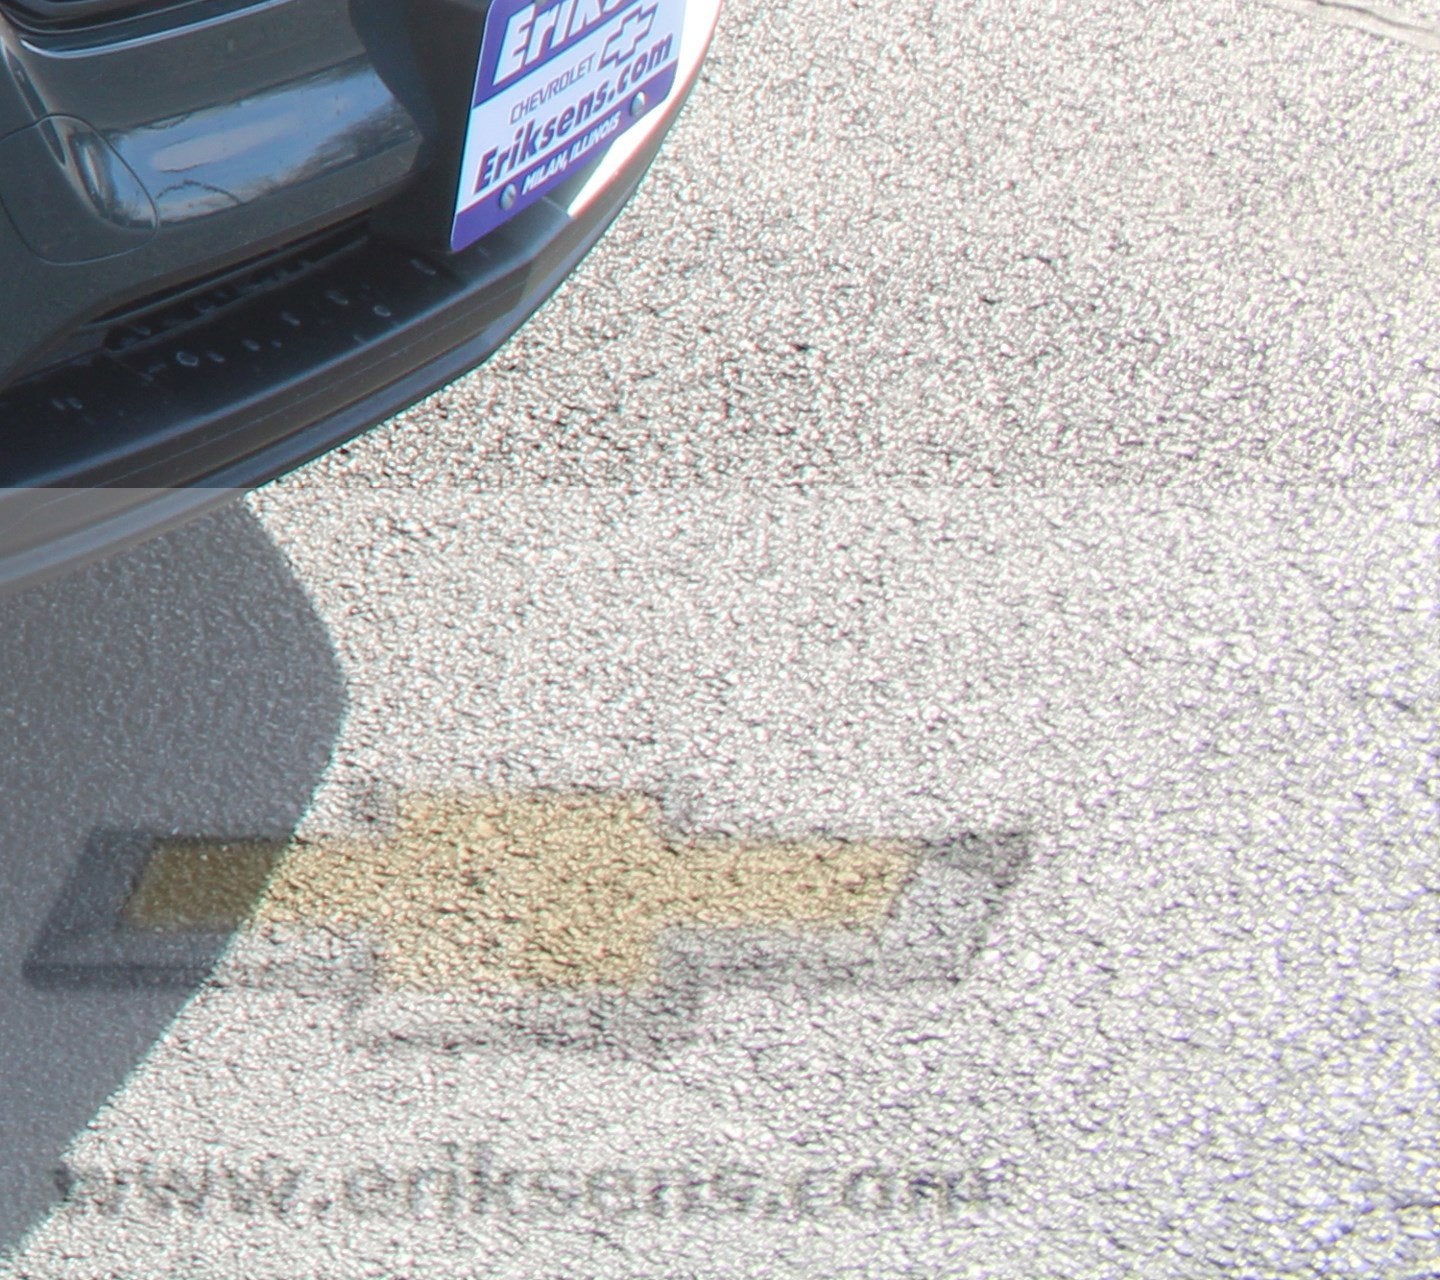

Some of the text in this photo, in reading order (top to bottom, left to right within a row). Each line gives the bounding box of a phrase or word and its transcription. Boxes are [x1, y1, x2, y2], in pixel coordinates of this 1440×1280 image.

[474, 33, 673, 194] Eriksens.com
[510, 52, 595, 125] CHEVROLET
[522, 110, 621, 195] MILAN, ILLINOIS
